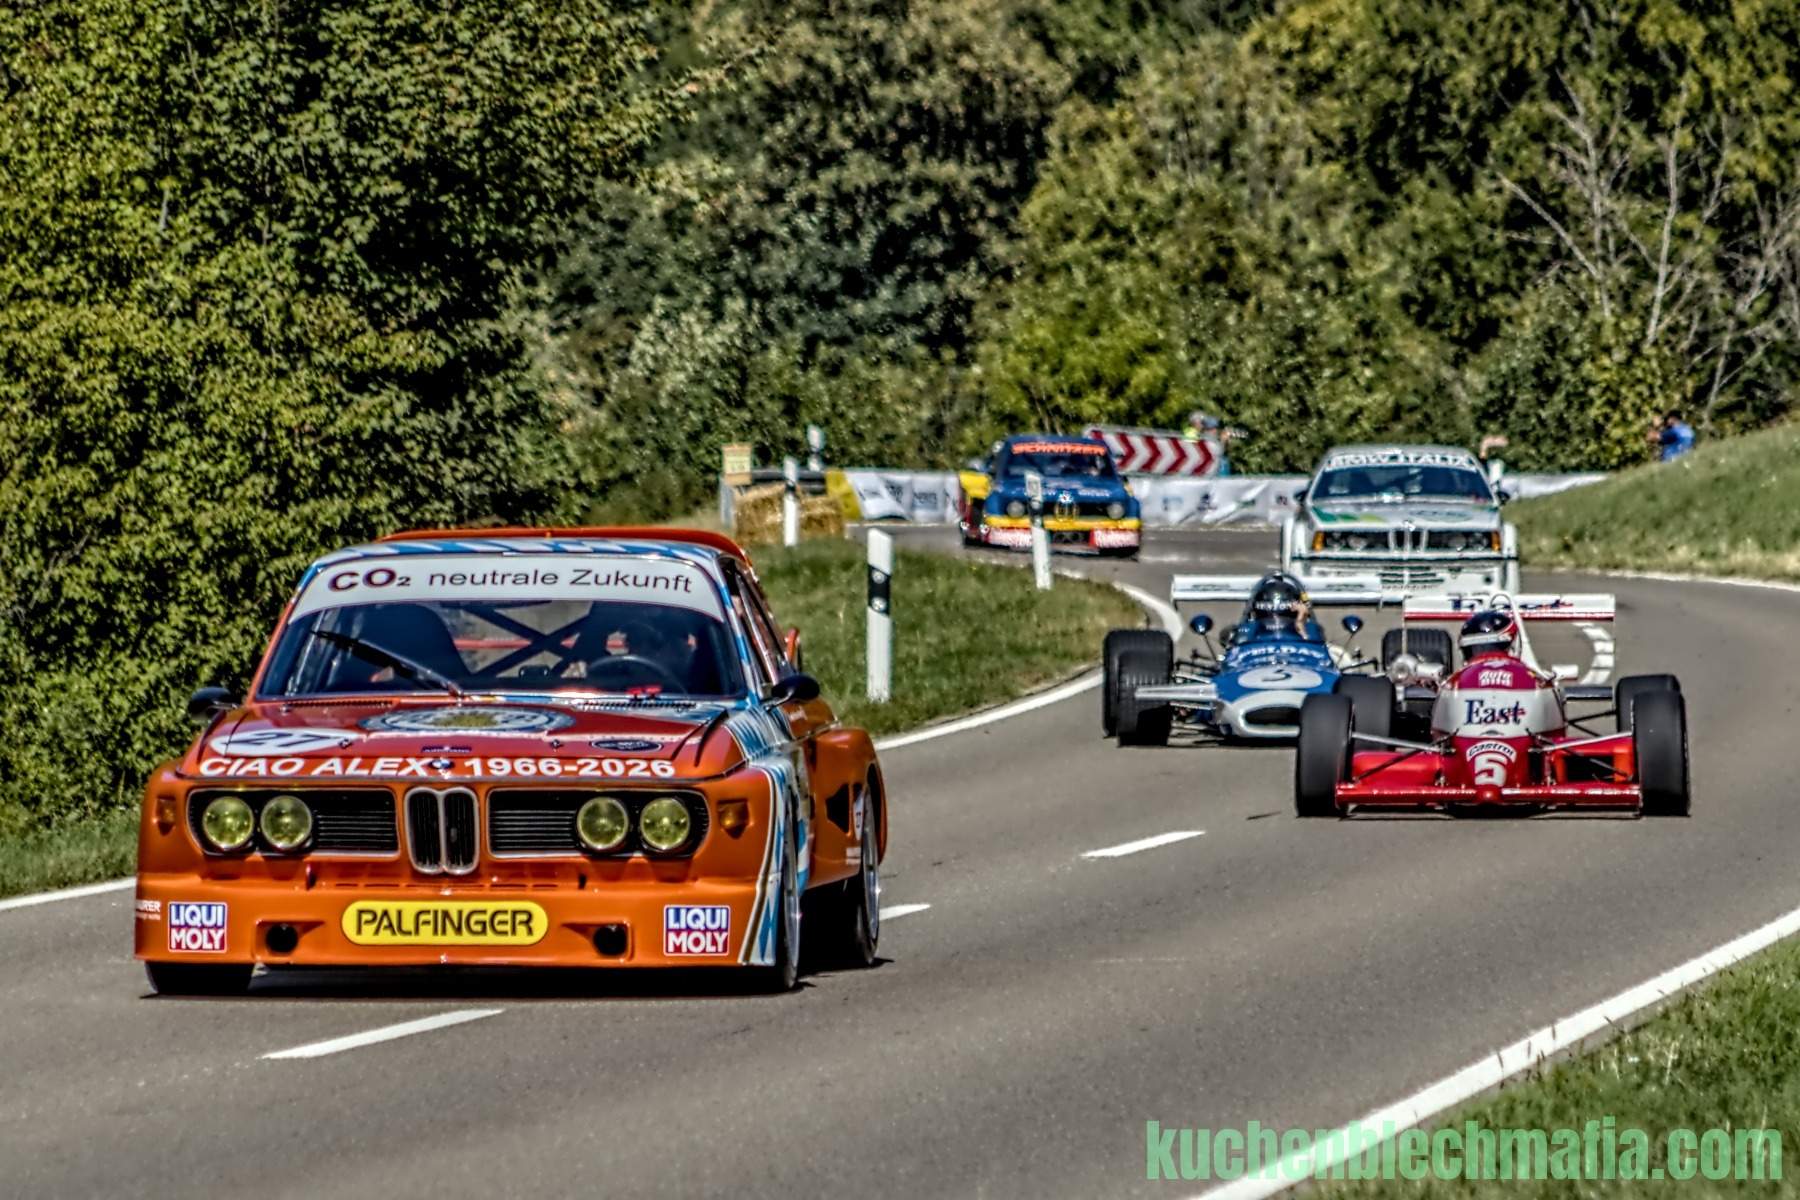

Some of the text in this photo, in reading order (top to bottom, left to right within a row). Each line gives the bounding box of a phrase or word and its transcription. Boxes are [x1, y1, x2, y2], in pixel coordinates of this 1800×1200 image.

[428, 568, 558, 586] neutrale
[569, 568, 693, 593] Zukunft
[1464, 699, 1527, 726] East
[220, 731, 331, 747] 27
[199, 757, 676, 778] CIAO ALEX 1966-2026
[1474, 753, 1507, 786] 5
[170, 904, 223, 928] LIQUI
[356, 908, 535, 937] PALFINGER
[667, 907, 727, 930] LIQUI
[170, 928, 225, 949] MOLY
[667, 931, 728, 953] MOLY
